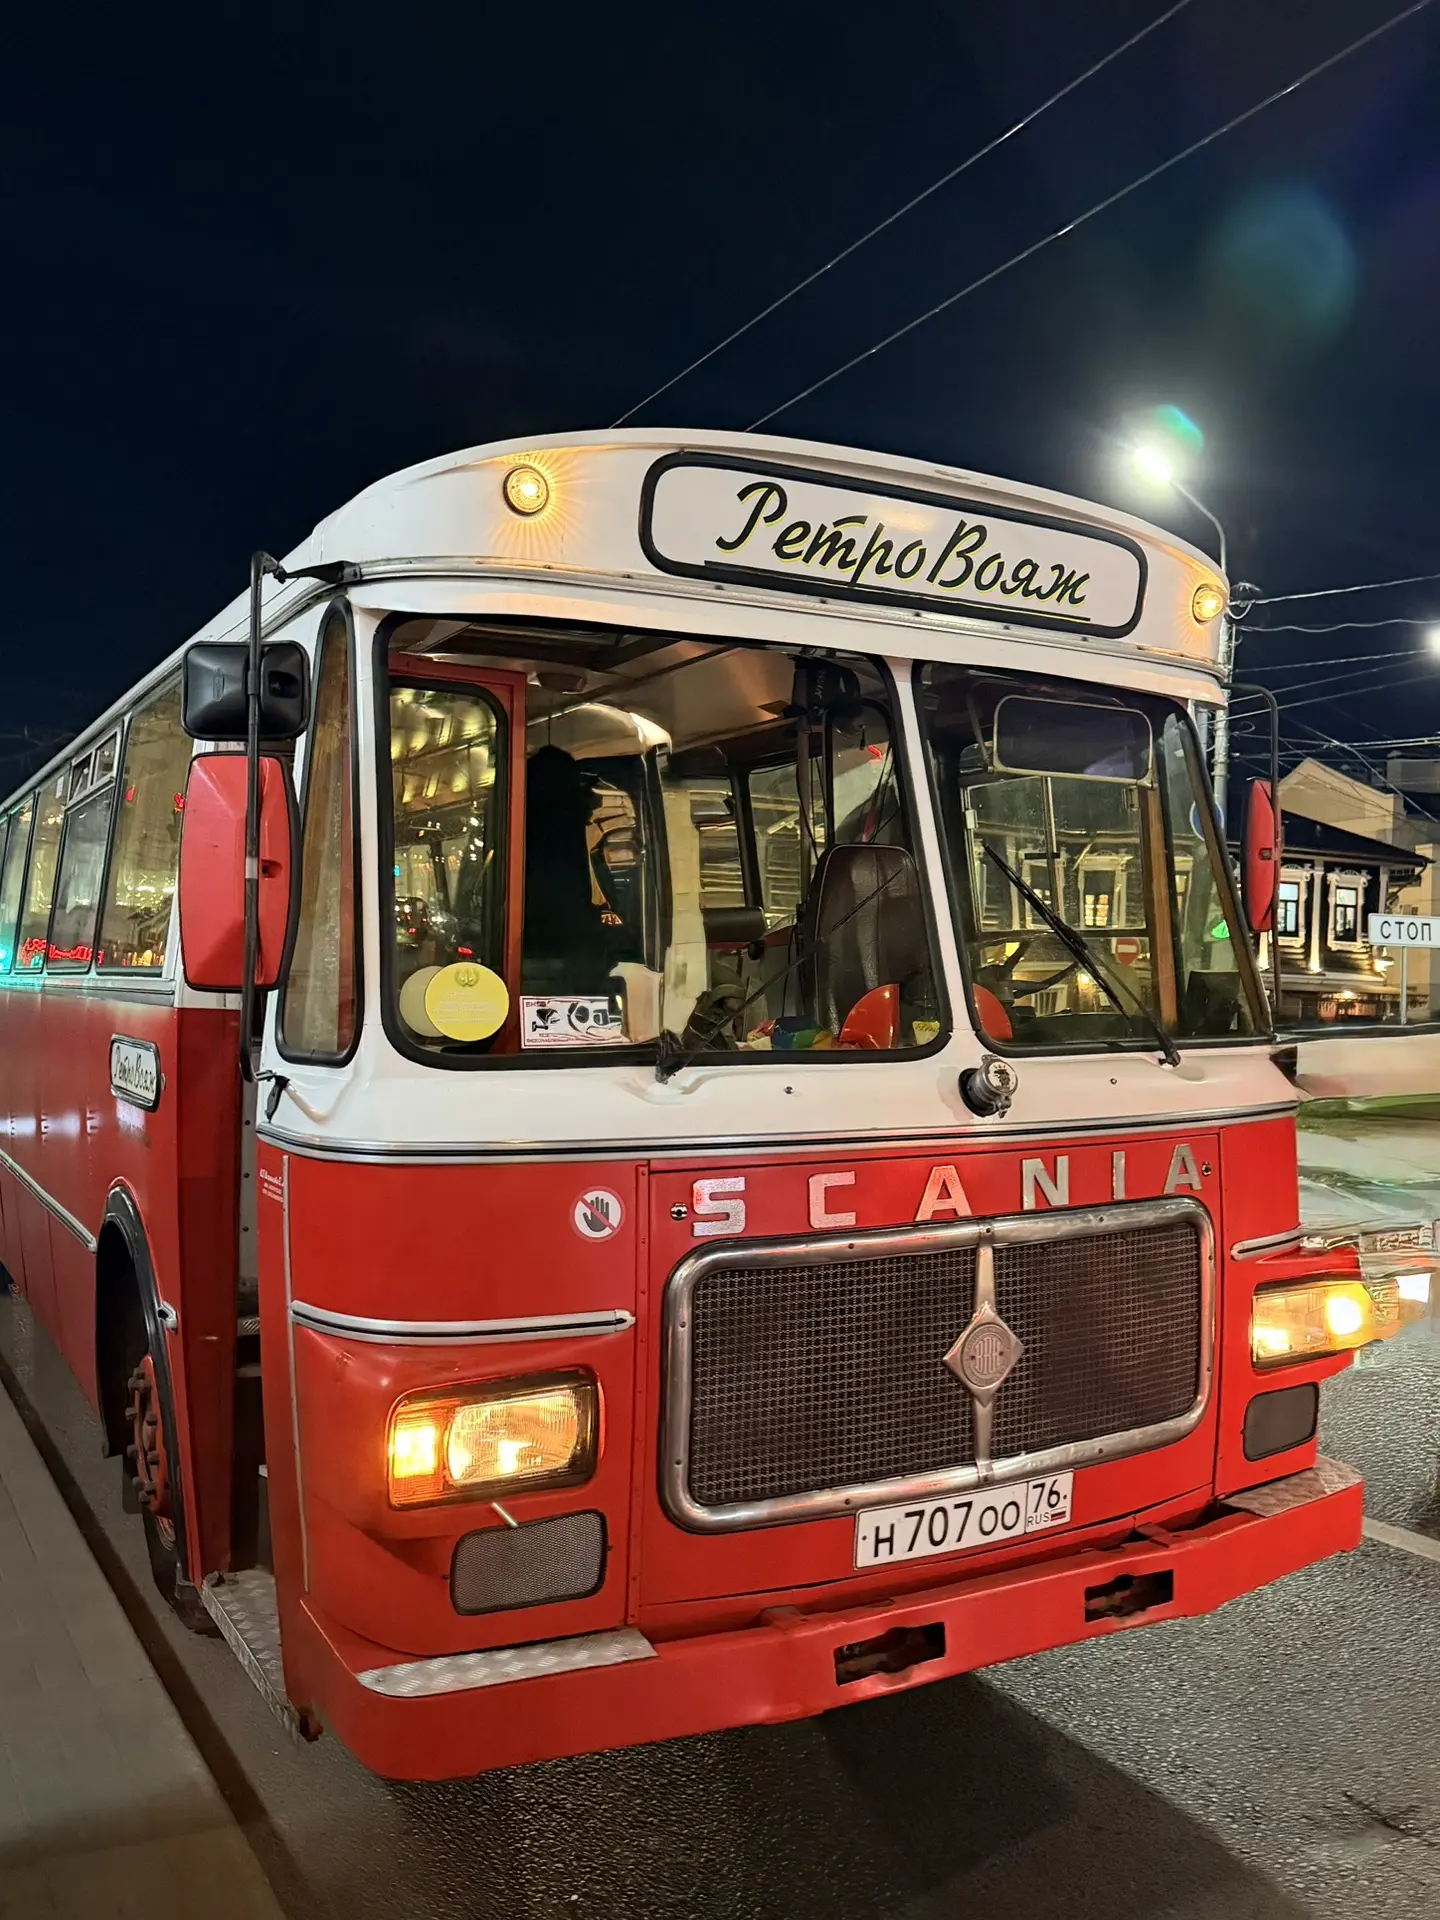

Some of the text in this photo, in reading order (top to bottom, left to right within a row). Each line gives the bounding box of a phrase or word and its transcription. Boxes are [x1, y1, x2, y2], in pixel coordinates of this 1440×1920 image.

[1380, 920, 1432, 941] СТОП
[692, 1143, 1204, 1237] SCANIA
[1032, 1479, 1062, 1514] 76
[1026, 1510, 1051, 1527] RUS
